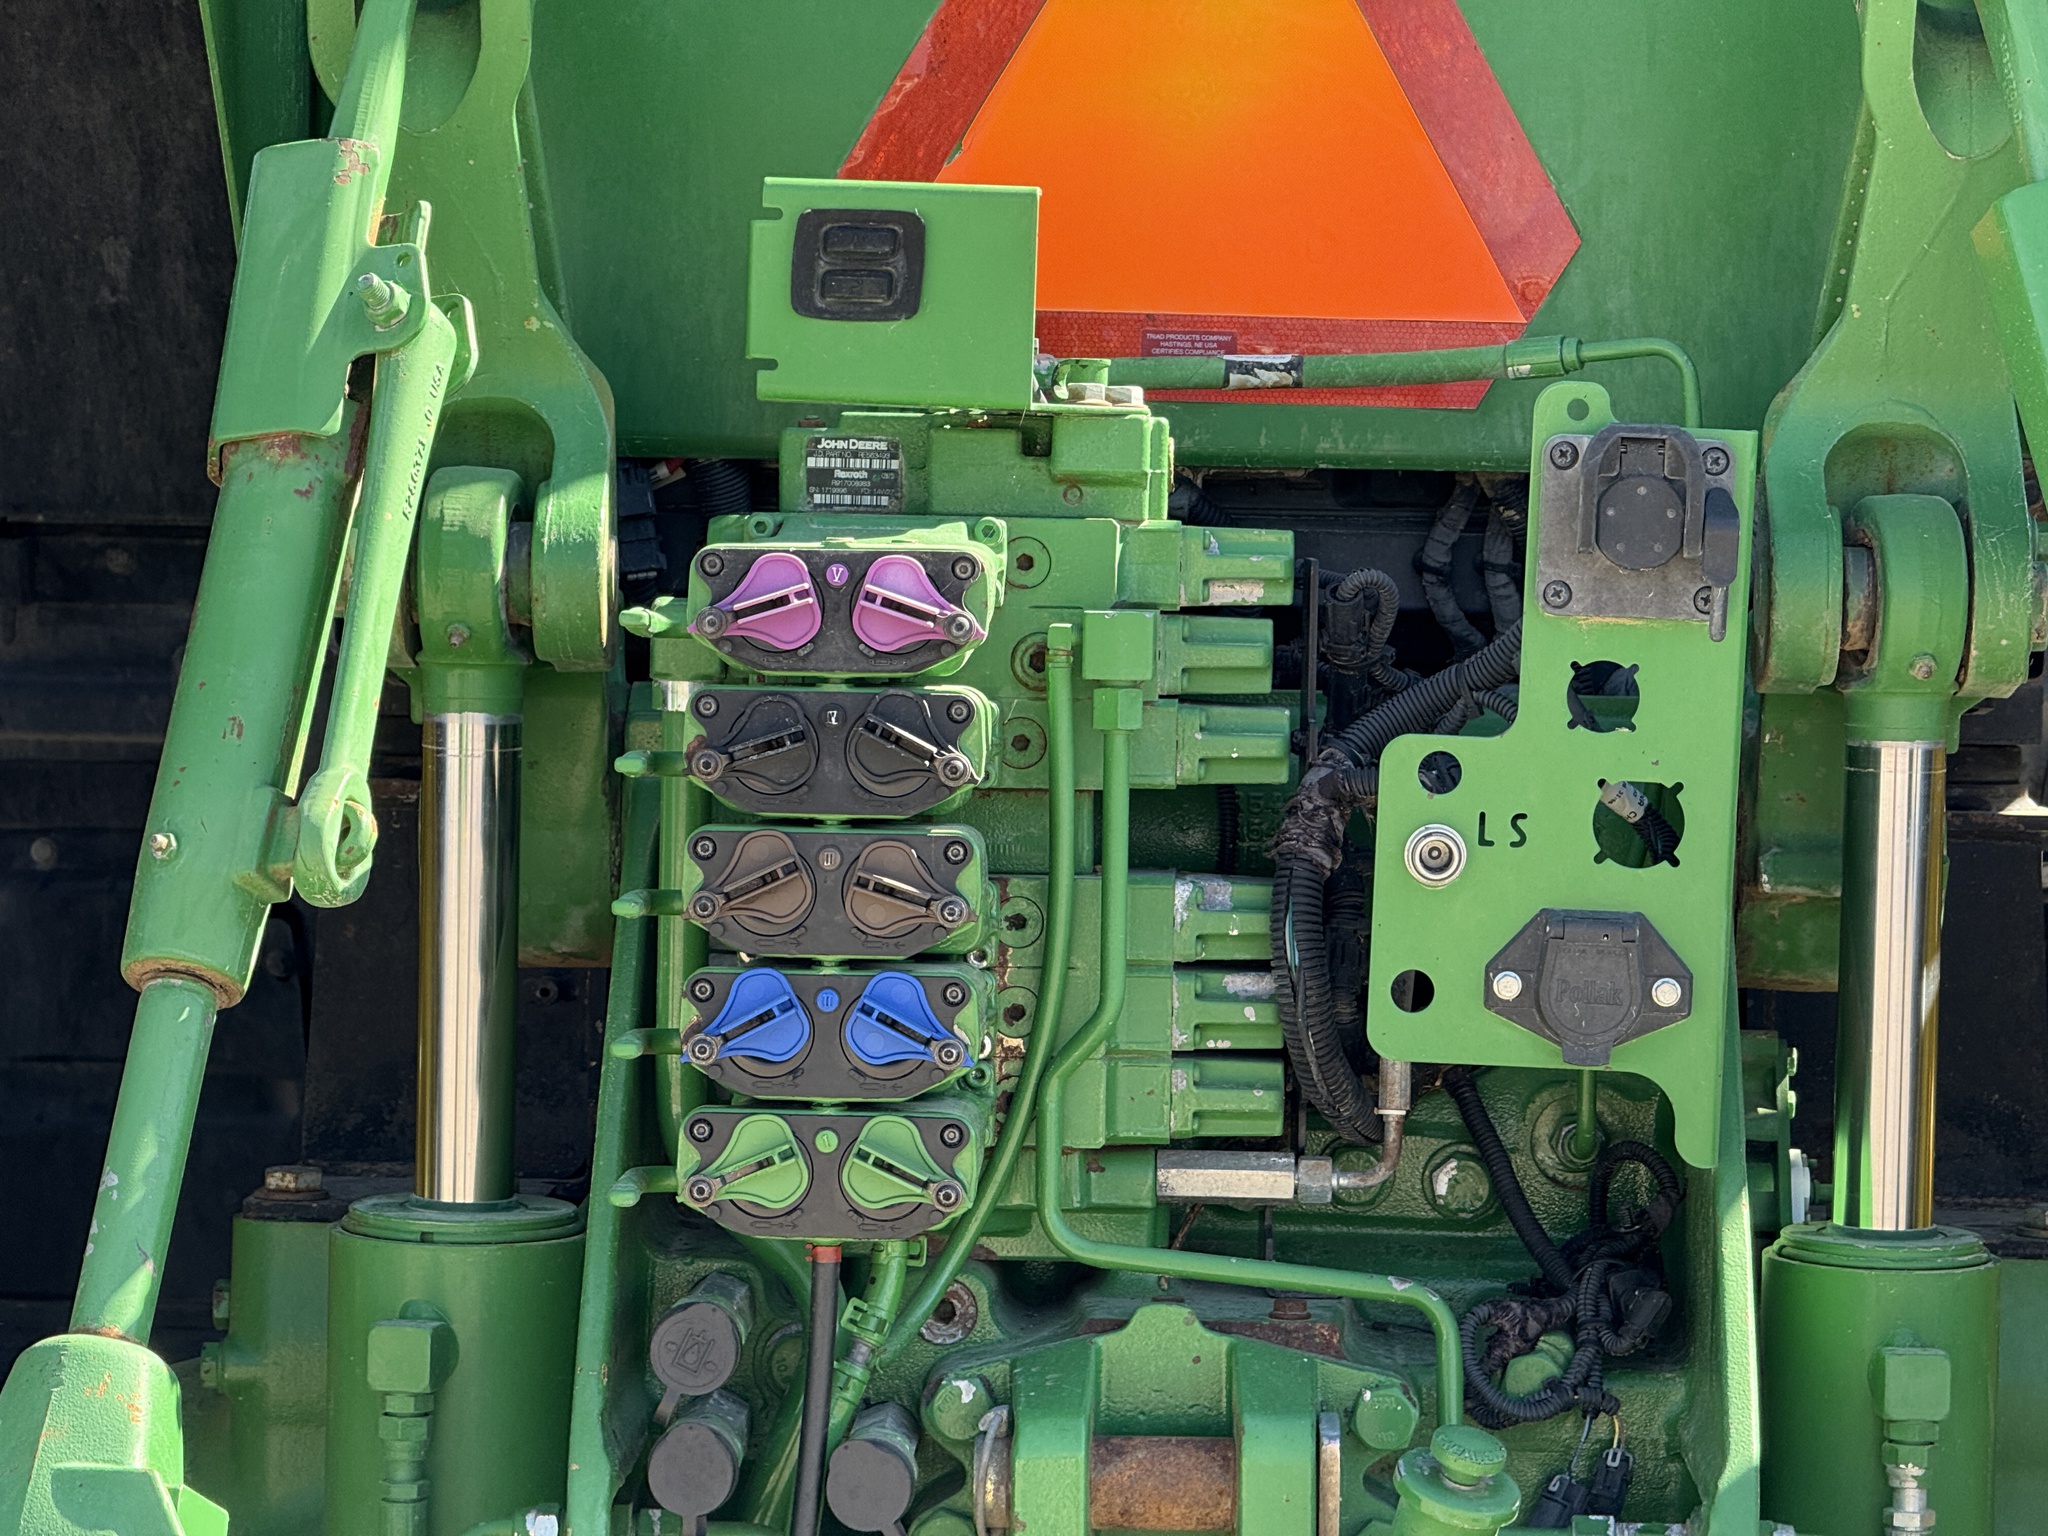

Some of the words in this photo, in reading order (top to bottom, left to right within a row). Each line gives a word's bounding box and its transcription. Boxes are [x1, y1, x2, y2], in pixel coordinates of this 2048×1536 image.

[1166, 333, 1200, 341] PRODUCTS
[429, 363, 444, 399] USA
[817, 438, 848, 449] JOHN
[849, 439, 888, 450] DEERE
[834, 469, 868, 479] Rexroth
[831, 566, 844, 583] V
[1555, 978, 1624, 1006] Pollak
